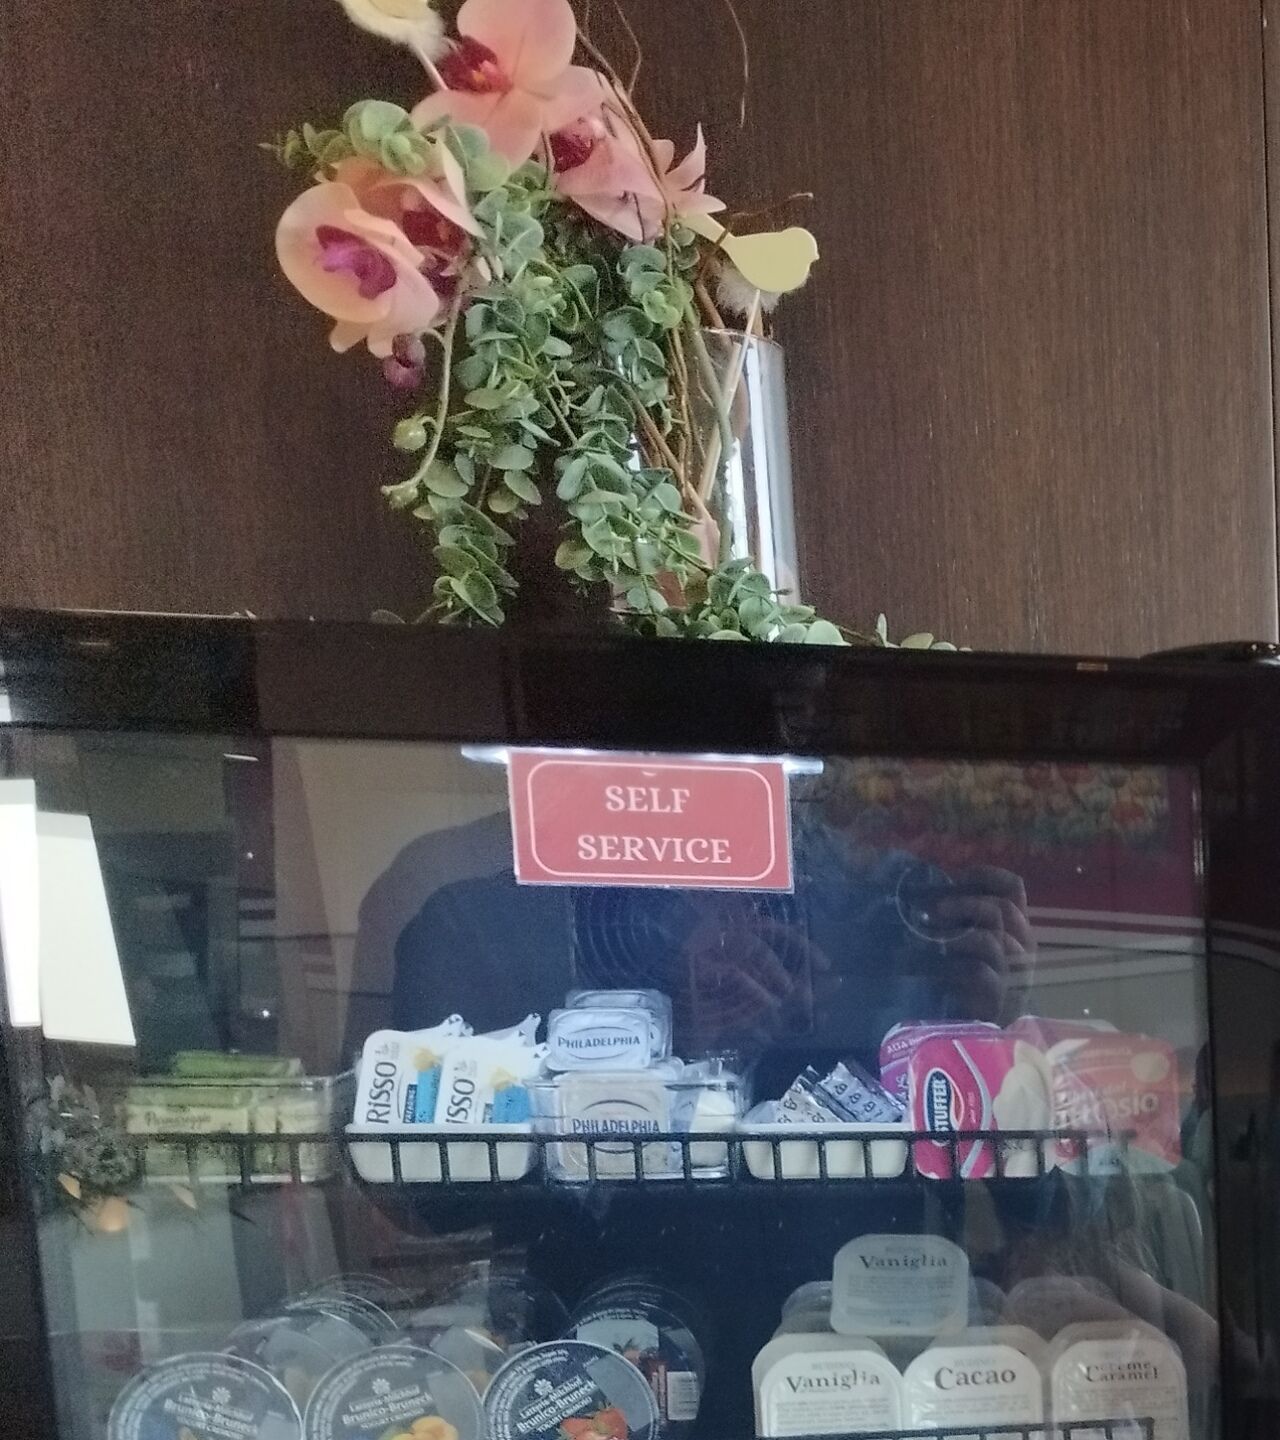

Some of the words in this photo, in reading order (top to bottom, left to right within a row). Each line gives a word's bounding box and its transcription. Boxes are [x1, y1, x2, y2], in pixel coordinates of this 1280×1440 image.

[605, 786, 690, 813] SELF
[577, 834, 731, 864] SERVICE
[557, 1035, 640, 1048] PHILADELPHIA
[933, 1076, 949, 1131] STUFFER
[572, 1118, 660, 1133] PHILADELPHIA
[859, 1253, 948, 1270] Vaniglia
[786, 1370, 880, 1394] Vaniglia
[934, 1366, 1016, 1390] Cacao
